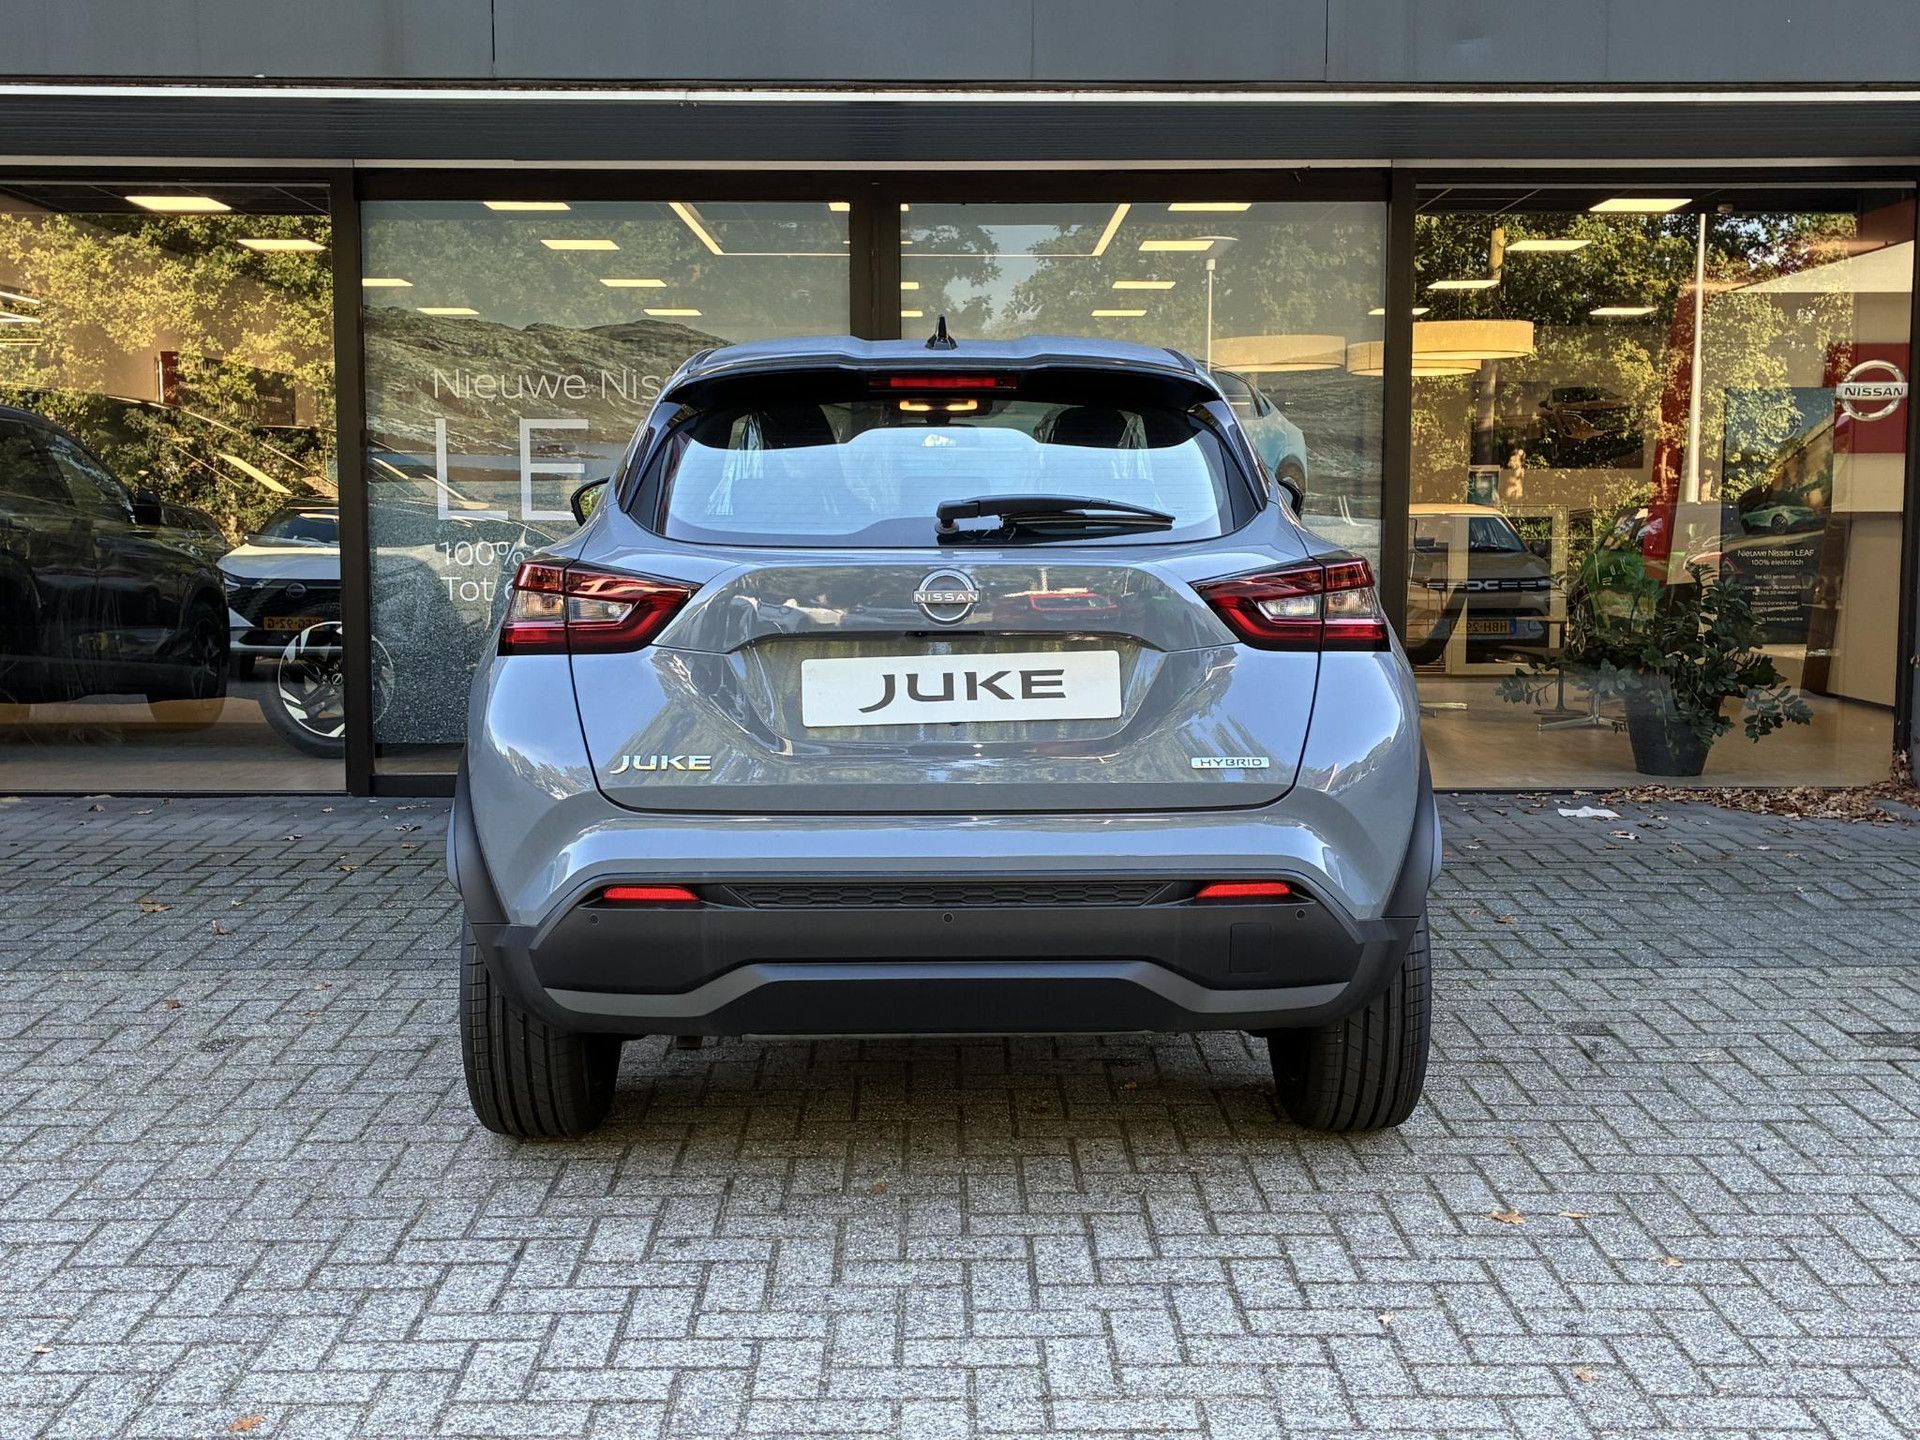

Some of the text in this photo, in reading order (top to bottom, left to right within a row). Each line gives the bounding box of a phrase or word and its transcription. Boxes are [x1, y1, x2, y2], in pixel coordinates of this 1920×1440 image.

[434, 368, 671, 400] Nieuwe Nis
[1844, 387, 1904, 397] NISSAN
[435, 418, 590, 521] LE
[440, 541, 525, 566] 100%
[1795, 549, 1815, 557] LEAF
[441, 577, 494, 601] Tot
[915, 592, 978, 602] NISSAN
[858, 669, 1067, 713] JUKE
[609, 755, 712, 775] JUKE
